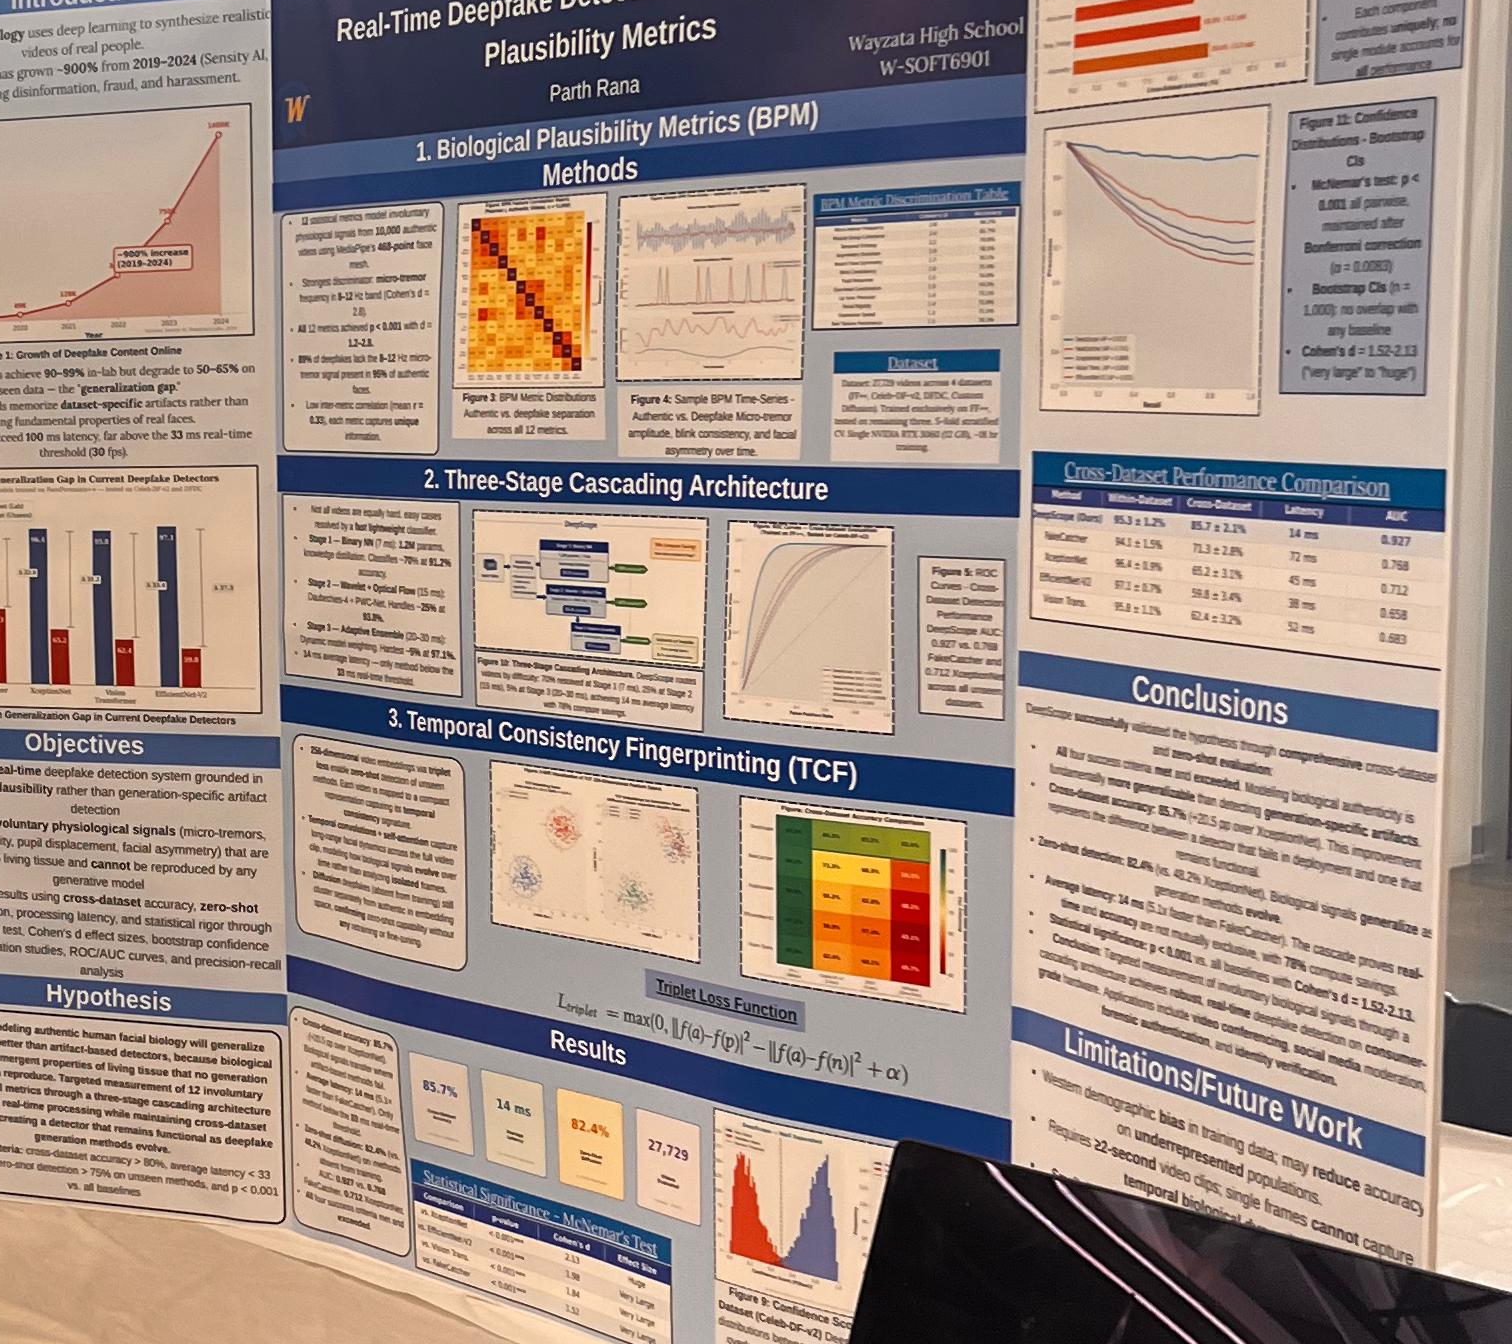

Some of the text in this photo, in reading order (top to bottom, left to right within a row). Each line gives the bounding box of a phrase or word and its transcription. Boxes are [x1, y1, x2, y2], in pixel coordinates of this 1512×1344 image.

[27, 28, 54, 39] uses
[56, 23, 86, 38] deep
[88, 21, 137, 35] learning
[139, 19, 153, 30] to
[155, 13, 220, 31] synthesize
[222, 7, 273, 27] realistic
[336, 4, 442, 44] Real-Time
[848, 15, 1024, 55] Wayzata High School
[21, 37, 145, 59] videos of real people.
[484, 15, 717, 68] Plausibility Metrics
[16, 67, 54, 83] grown
[101, 59, 130, 73] from
[199, 51, 250, 68] (Sensity
[879, 49, 990, 76] W-SOFT6901
[11, 82, 101, 99] disinformation,
[103, 77, 139, 92] fraud,
[140, 74, 164, 90] and
[166, 72, 241, 88] harassment.
[549, 77, 640, 102] Parth Rana
[416, 100, 819, 162] 1. Biological Plausibility Metrics (BPM)
[542, 155, 642, 191] Methods
[820, 187, 1009, 213] BPM Metric Discrimination Table
[15, 349, 51, 360] Growth
[51, 348, 63, 359] of
[63, 347, 108, 360] Deepfake
[109, 347, 149, 358] Content
[150, 345, 183, 357] Online
[887, 356, 939, 372] Dataset
[4, 369, 42, 380] achieve
[87, 366, 118, 378] in-lab
[118, 366, 137, 377] but
[138, 364, 181, 379] degrade
[182, 365, 195, 376] to
[241, 364, 256, 374] on
[630, 393, 661, 408] Figure
[674, 393, 709, 407] Sample
[710, 393, 733, 405] BPM
[734, 392, 789, 405] Time-Series
[423, 467, 829, 502] 2. Three-Stage Cascading Architecture
[1063, 460, 1391, 502] Cross-Dataset Performance Comparison
[1131, 675, 1289, 726] Conclusions
[23, 728, 145, 758] Objectives
[388, 707, 858, 793] 3. Temporal Consistency Fingerprinting (TCF)
[43, 765, 95, 780] deepfake
[96, 767, 149, 781] detection
[151, 770, 192, 784] system
[194, 771, 250, 785] grounded
[252, 772, 264, 784] in
[55, 784, 89, 797] rather
[90, 785, 116, 798] than
[118, 788, 225, 803] generation-specific
[227, 790, 268, 804] artifact
[70, 802, 121, 817] detection
[45, 983, 172, 1013] Hypothesis
[655, 978, 797, 1022] Triplet Loss Function
[550, 1029, 627, 1066] Results
[422, 1079, 458, 1098] 85.7%
[1064, 1026, 1366, 1150] Limitations/Future Work
[496, 1098, 532, 1117] 14 ms
[570, 1118, 610, 1138] 82.4%
[648, 1138, 689, 1161] 27,729
[1042, 1069, 1425, 1218] Western demographic bias in training data; may reduce accuracy
[1116, 1123, 1322, 1206] on underrepresented populations.
[424, 1170, 478, 1196] Statistical
[480, 1186, 550, 1218] Significance
[562, 1212, 630, 1246] McNemar's
[632, 1234, 658, 1256] Test
